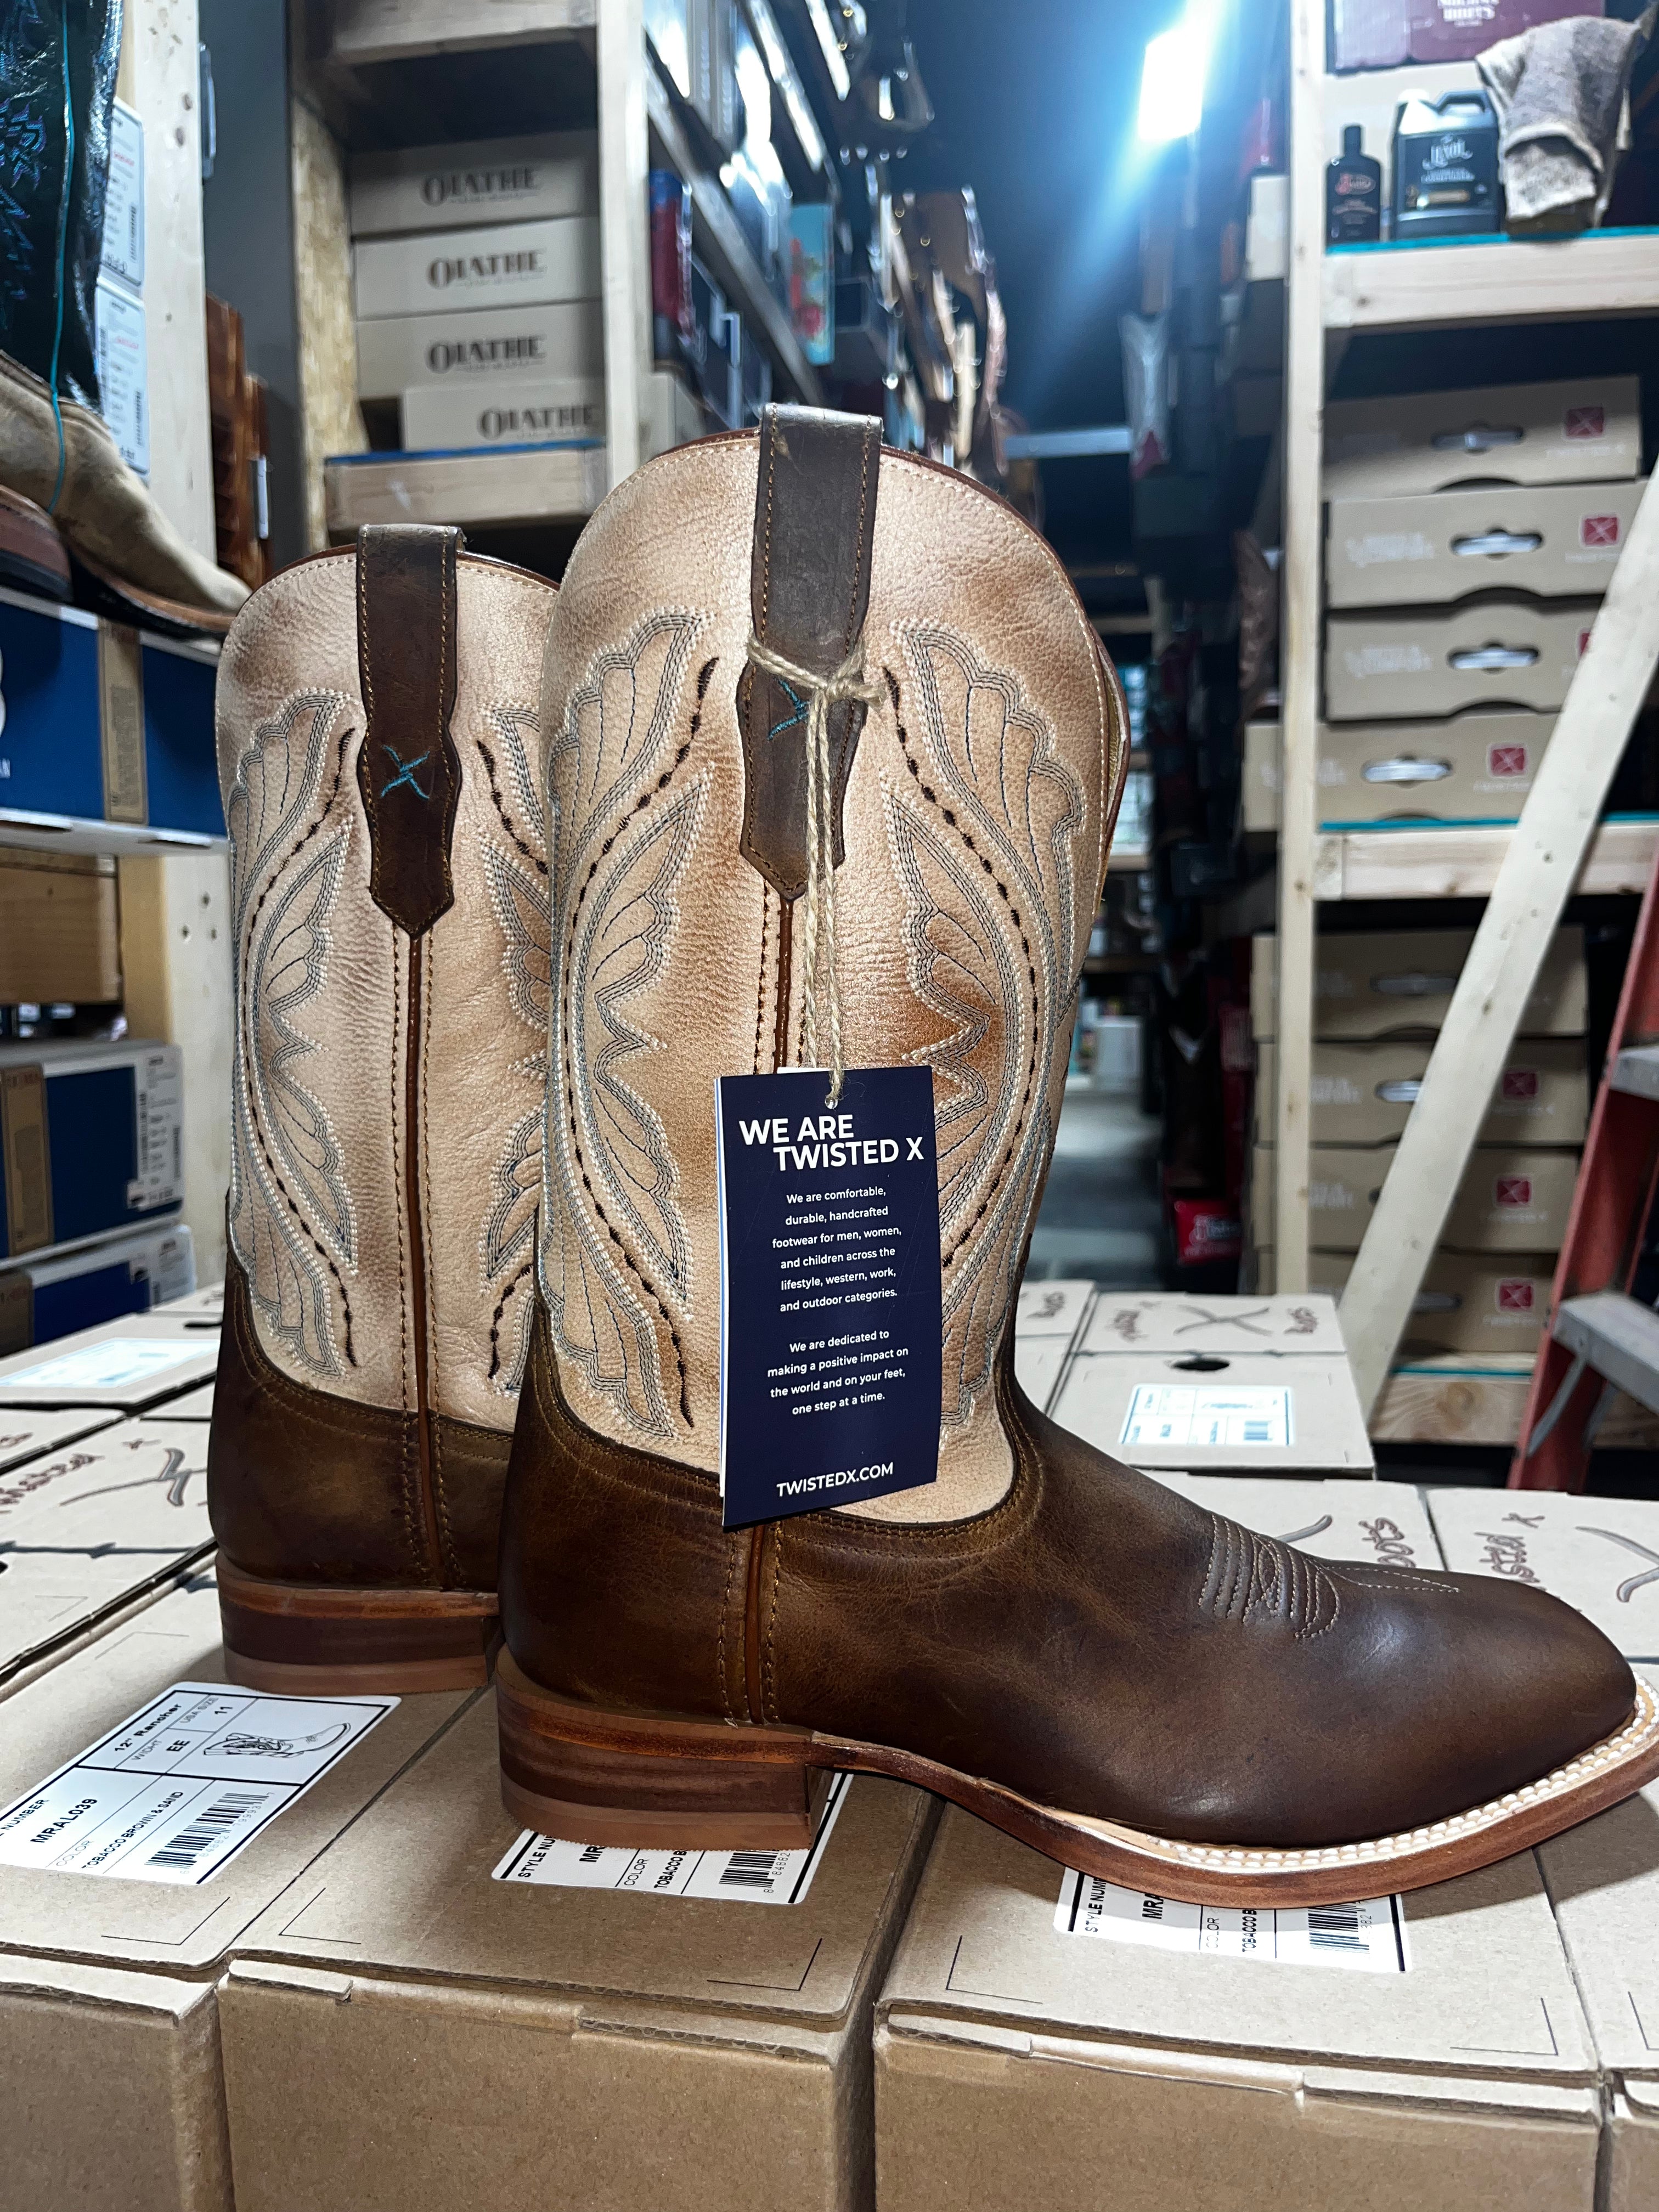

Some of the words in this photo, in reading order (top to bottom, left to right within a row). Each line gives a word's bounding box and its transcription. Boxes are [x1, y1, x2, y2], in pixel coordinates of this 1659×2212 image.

[738, 1118, 789, 1146] WE
[797, 1114, 854, 1142] ARE
[772, 1139, 899, 1171] TWISTED
[905, 1136, 924, 1161] X
[786, 1194, 804, 1204] We
[805, 1193, 822, 1203] are
[824, 1186, 886, 1200] comfortable,
[785, 1212, 827, 1226] durable,
[829, 1205, 888, 1221] handcrafted
[772, 1236, 818, 1249] footwear
[820, 1233, 834, 1243] for
[837, 1232, 861, 1242] men,
[863, 1227, 902, 1238] women,
[780, 1257, 800, 1269] and
[803, 1254, 844, 1266] children
[846, 1250, 877, 1261] across
[879, 1247, 895, 1257] the
[781, 1277, 823, 1290] lifestyle,
[825, 1272, 867, 1285] western,
[869, 1267, 896, 1279] work,
[780, 1300, 800, 1312] and
[802, 1296, 843, 1309] outdoor
[844, 1288, 898, 1303] categories.
[789, 1342, 806, 1353] We
[809, 1340, 825, 1350] are
[827, 1330, 877, 1347] dedicated
[879, 1330, 889, 1339] to
[768, 1363, 807, 1378] making
[819, 1355, 858, 1372] positive
[860, 1349, 894, 1363] impact
[896, 1348, 909, 1357] on
[770, 1387, 788, 1398] the
[791, 1380, 820, 1395] world
[822, 1376, 842, 1389] and
[844, 1376, 857, 1386] on
[859, 1372, 882, 1386] your
[884, 1368, 905, 1379] feet,
[792, 1404, 812, 1415] one
[814, 1401, 837, 1412] step
[839, 1397, 849, 1407] at
[851, 1397, 857, 1405] a
[860, 1392, 885, 1403] time.
[776, 1462, 893, 1497] TWISTEDX.COM
[133, 1704, 182, 1736] Rancher
[215, 1706, 233, 1715] 11
[166, 1740, 191, 1752] EE
[1, 1799, 50, 1830] NUMBER
[30, 1799, 98, 1843] MRAL039
[81, 1838, 127, 1869] TOBACCO
[121, 1814, 157, 1837] BROWN
[157, 1791, 184, 1808] SAND
[56, 1841, 94, 1866] COLOR
[518, 1852, 547, 1878] STYLE
[624, 1858, 649, 1886] COLOR
[653, 1857, 684, 1888] TOBACCO
[1085, 1903, 1103, 1932] STYLE
[1242, 1916, 1257, 1952] TOBACCO
